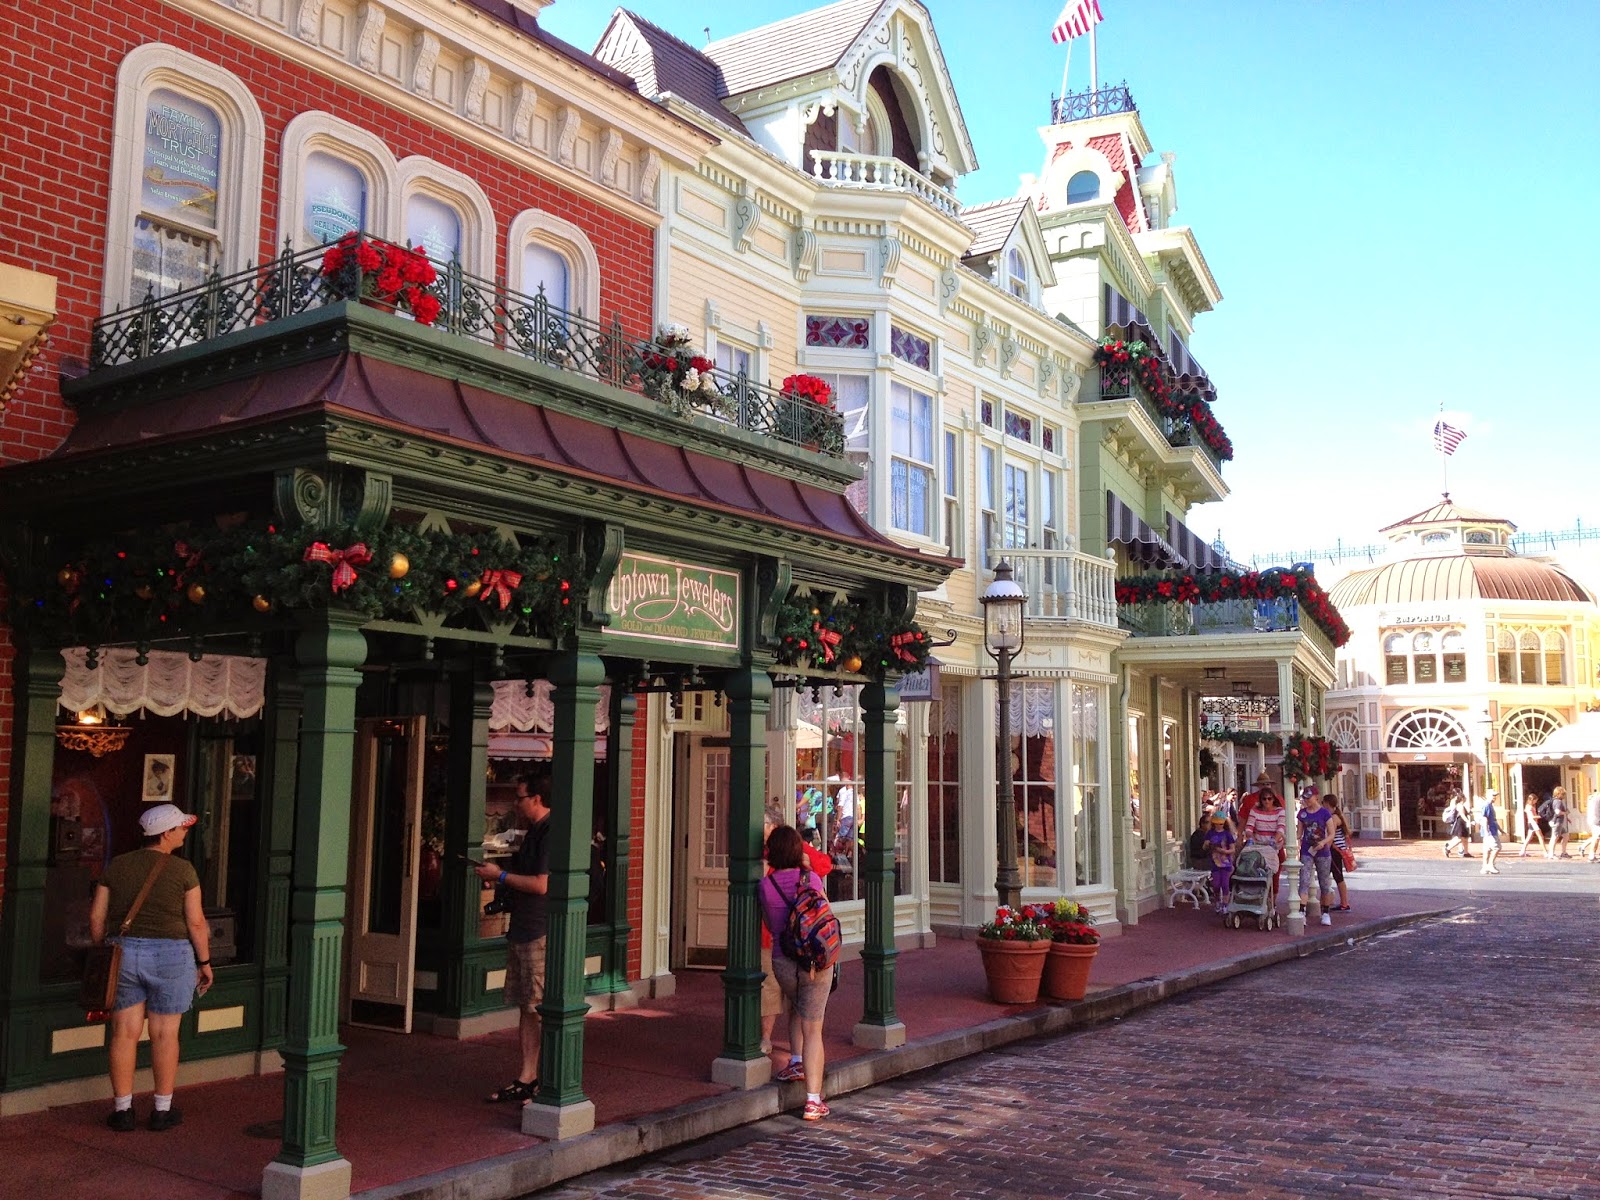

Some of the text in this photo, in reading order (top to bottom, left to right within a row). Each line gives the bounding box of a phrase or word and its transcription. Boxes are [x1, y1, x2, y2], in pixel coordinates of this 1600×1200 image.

[162, 106, 205, 131] FAMILY
[149, 110, 217, 158] MORTGAGE
[161, 137, 204, 161] TRUST
[312, 205, 358, 227] PSEUDONYM
[314, 220, 331, 231] REAL
[610, 559, 733, 631] Uptown Jewelers
[622, 619, 643, 632] GOLD
[654, 623, 688, 638] DIAMOND
[690, 630, 723, 641] JEWELRY
